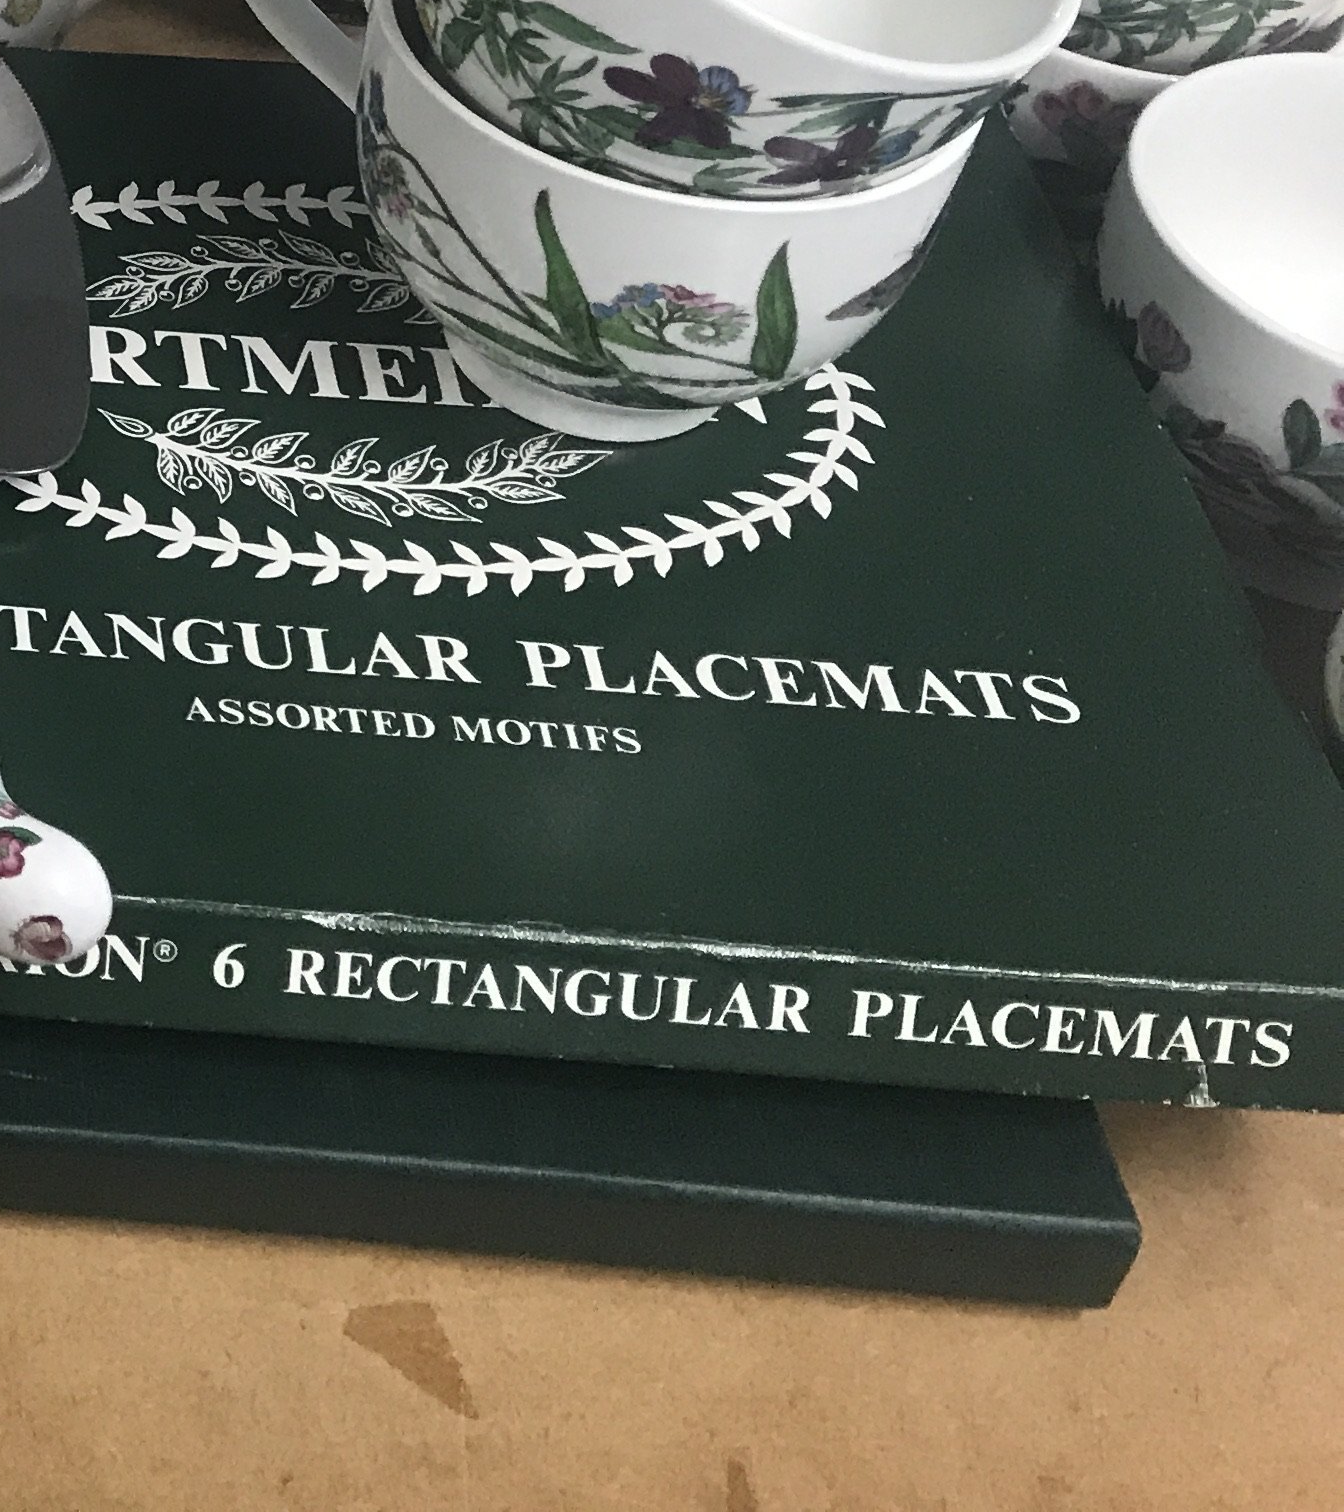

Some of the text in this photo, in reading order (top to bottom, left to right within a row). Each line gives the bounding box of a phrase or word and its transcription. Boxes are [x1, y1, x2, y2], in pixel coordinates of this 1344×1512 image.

[185, 696, 642, 754] ASSORTED MOTIFS
[515, 638, 1082, 725] PLACEMATS
[212, 943, 249, 988] 6
[283, 948, 811, 1034] RECTANGULAR
[847, 989, 1294, 1068] PLACEMATS
